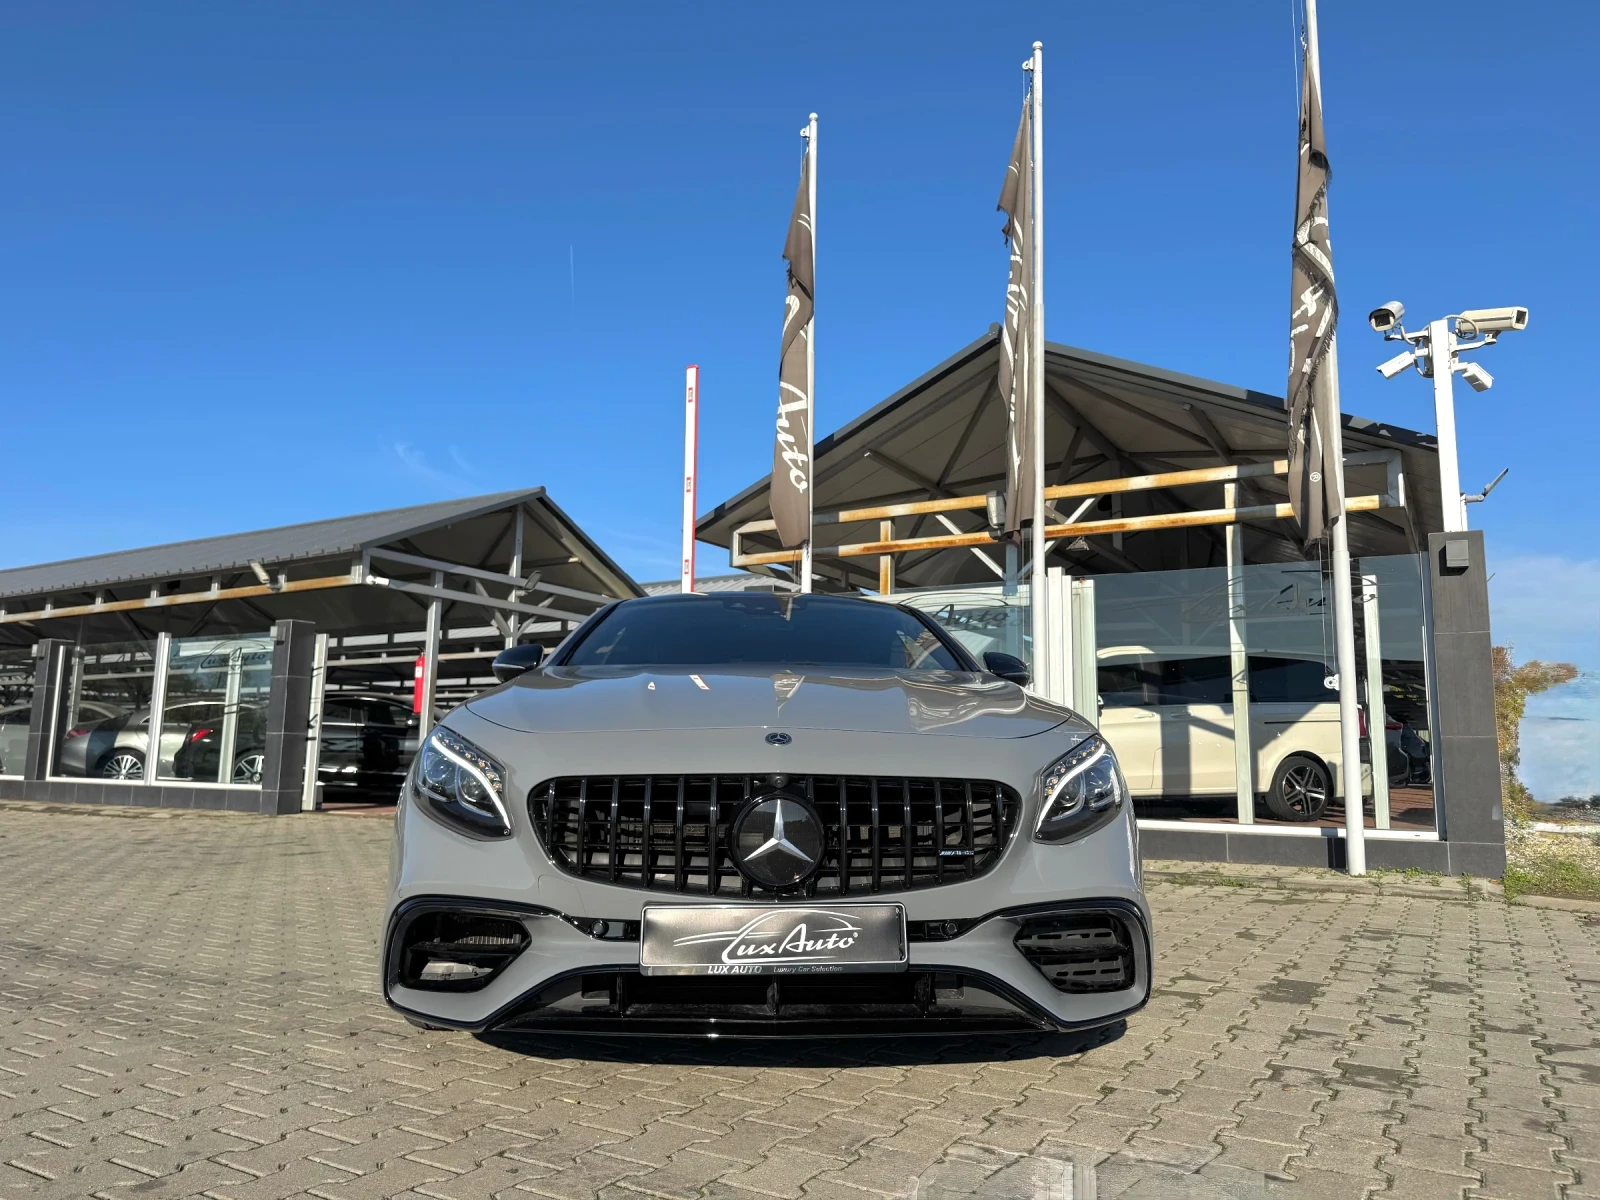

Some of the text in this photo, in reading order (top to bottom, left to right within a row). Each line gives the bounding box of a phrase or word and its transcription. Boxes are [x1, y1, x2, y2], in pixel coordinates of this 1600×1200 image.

[776, 381, 808, 493] Auto
[721, 922, 856, 964] Lux Auto
[707, 965, 763, 975] LUX AUTO
[811, 965, 843, 973] Selection
